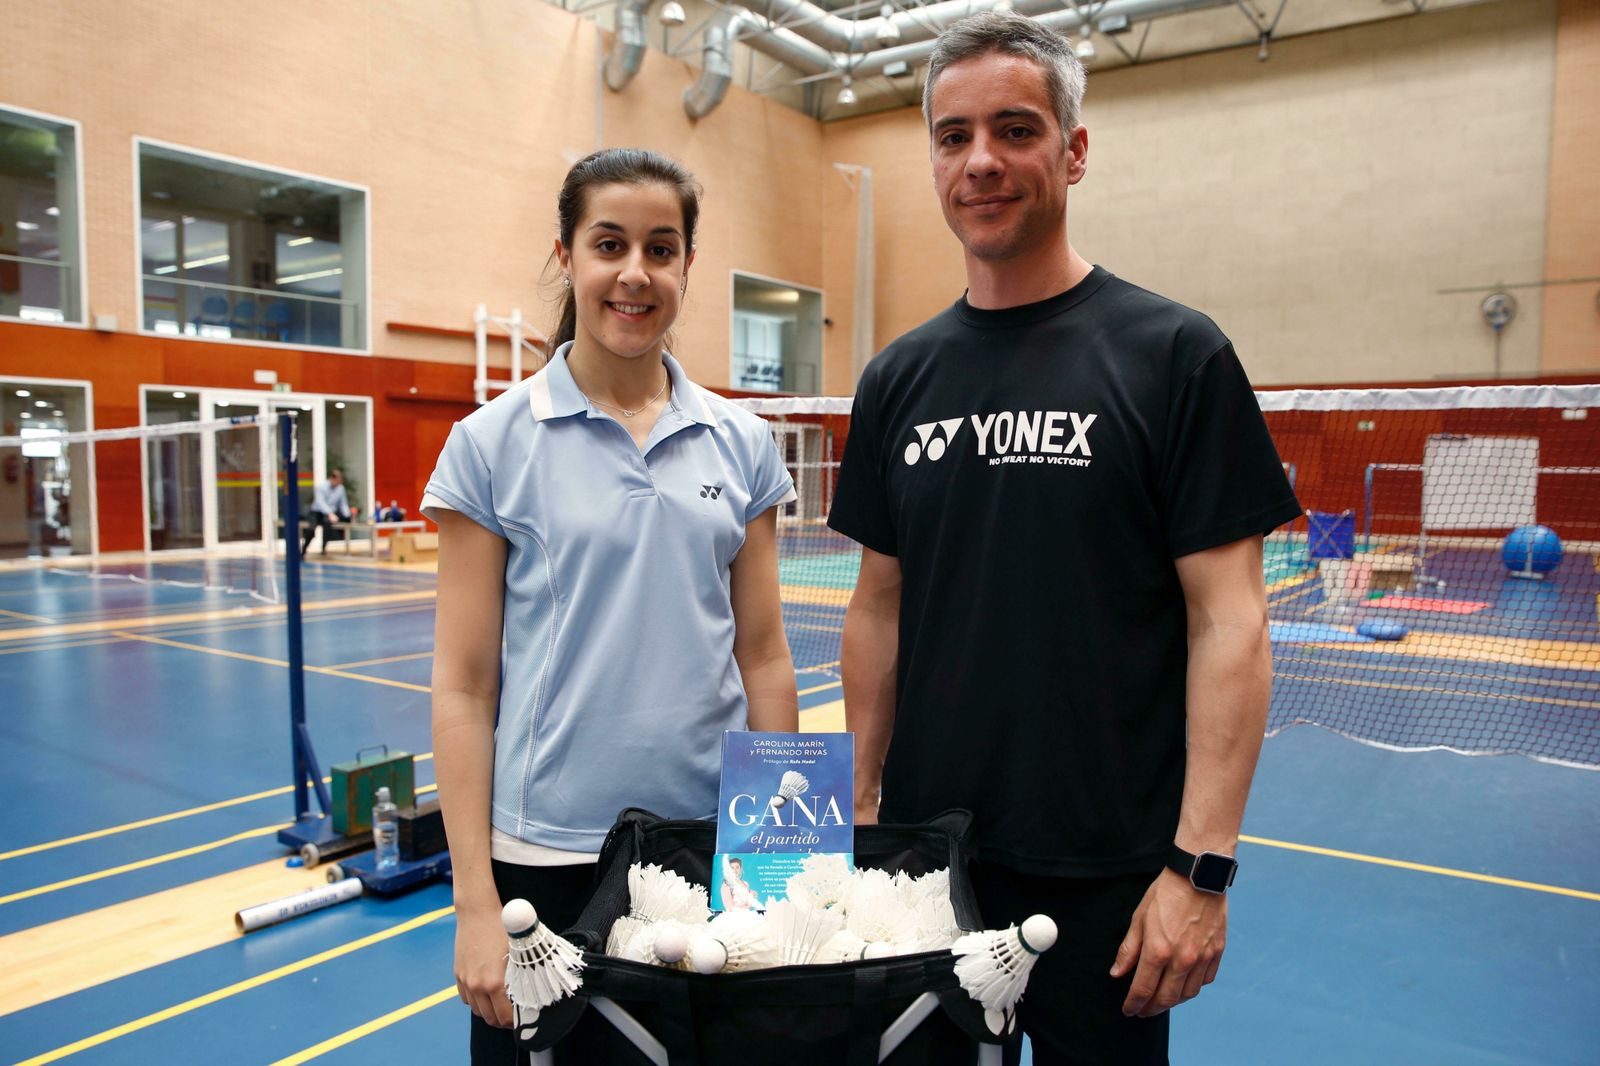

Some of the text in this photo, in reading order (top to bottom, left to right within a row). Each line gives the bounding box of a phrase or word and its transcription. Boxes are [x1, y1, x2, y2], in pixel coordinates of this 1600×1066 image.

[970, 410, 1098, 456] YONEX
[1029, 456, 1044, 464] NO
[1046, 456, 1091, 467] VICTORY
[754, 740, 824, 748] CAROLINA MARÍN
[756, 748, 802, 756] FERNANDO
[728, 793, 848, 827] GANA
[750, 831, 820, 848] el partido
